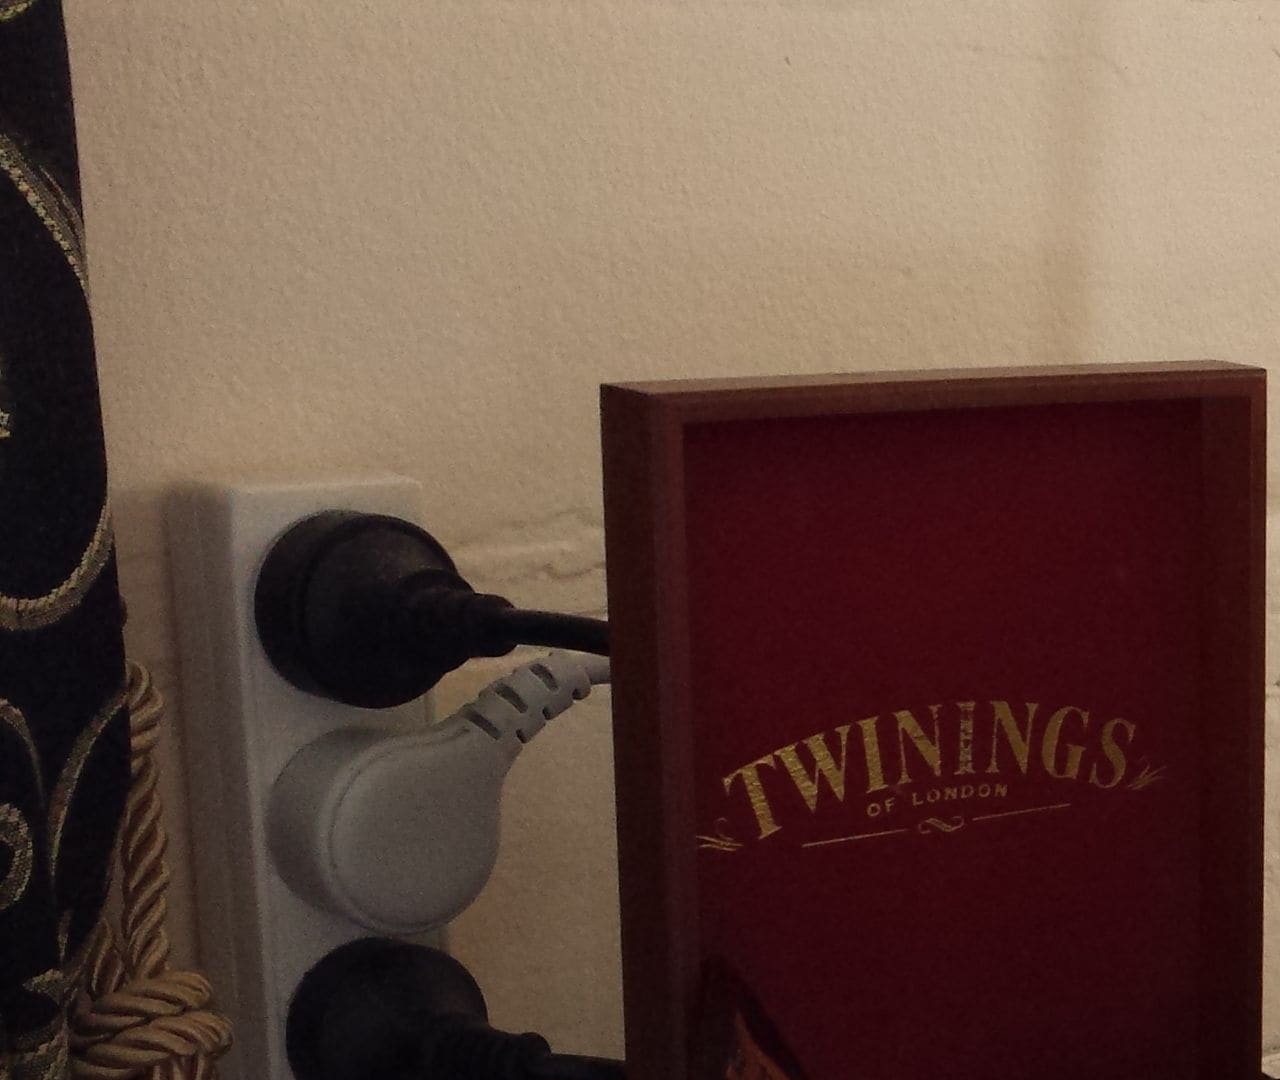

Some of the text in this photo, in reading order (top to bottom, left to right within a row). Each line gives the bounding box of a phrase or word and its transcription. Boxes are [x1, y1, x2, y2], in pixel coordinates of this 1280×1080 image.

[722, 700, 1137, 841] TWININGS
[866, 783, 1008, 817] OF LONDON
